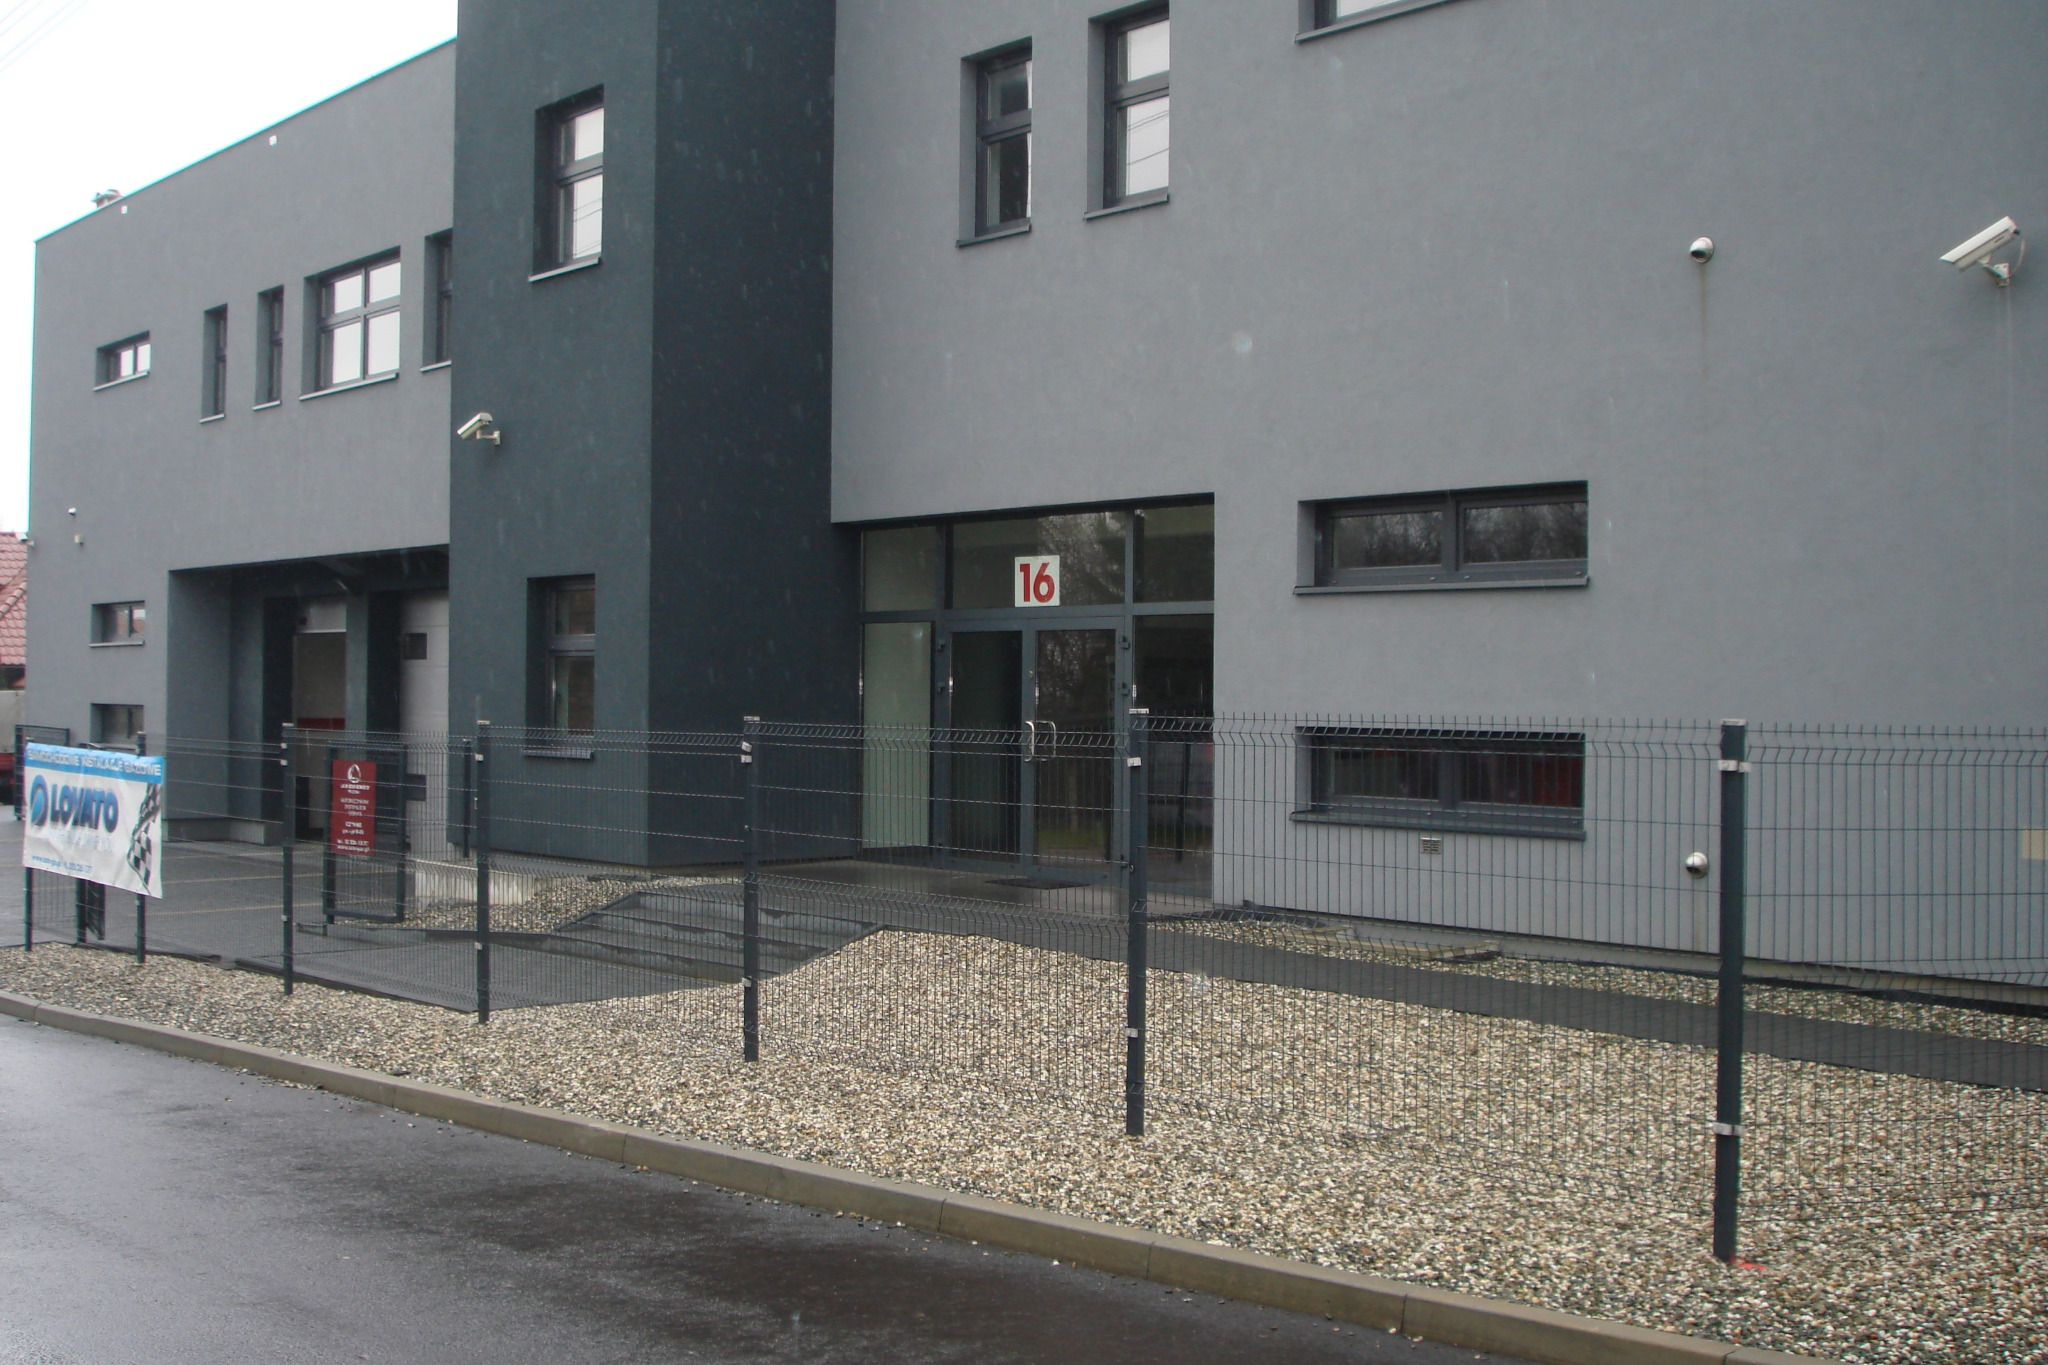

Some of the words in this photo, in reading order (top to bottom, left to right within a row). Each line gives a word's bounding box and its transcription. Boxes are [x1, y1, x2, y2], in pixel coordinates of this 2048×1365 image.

[1019, 562, 1055, 604] 16
[123, 761, 162, 777] GAZOWE
[50, 783, 119, 833] LOVATO
